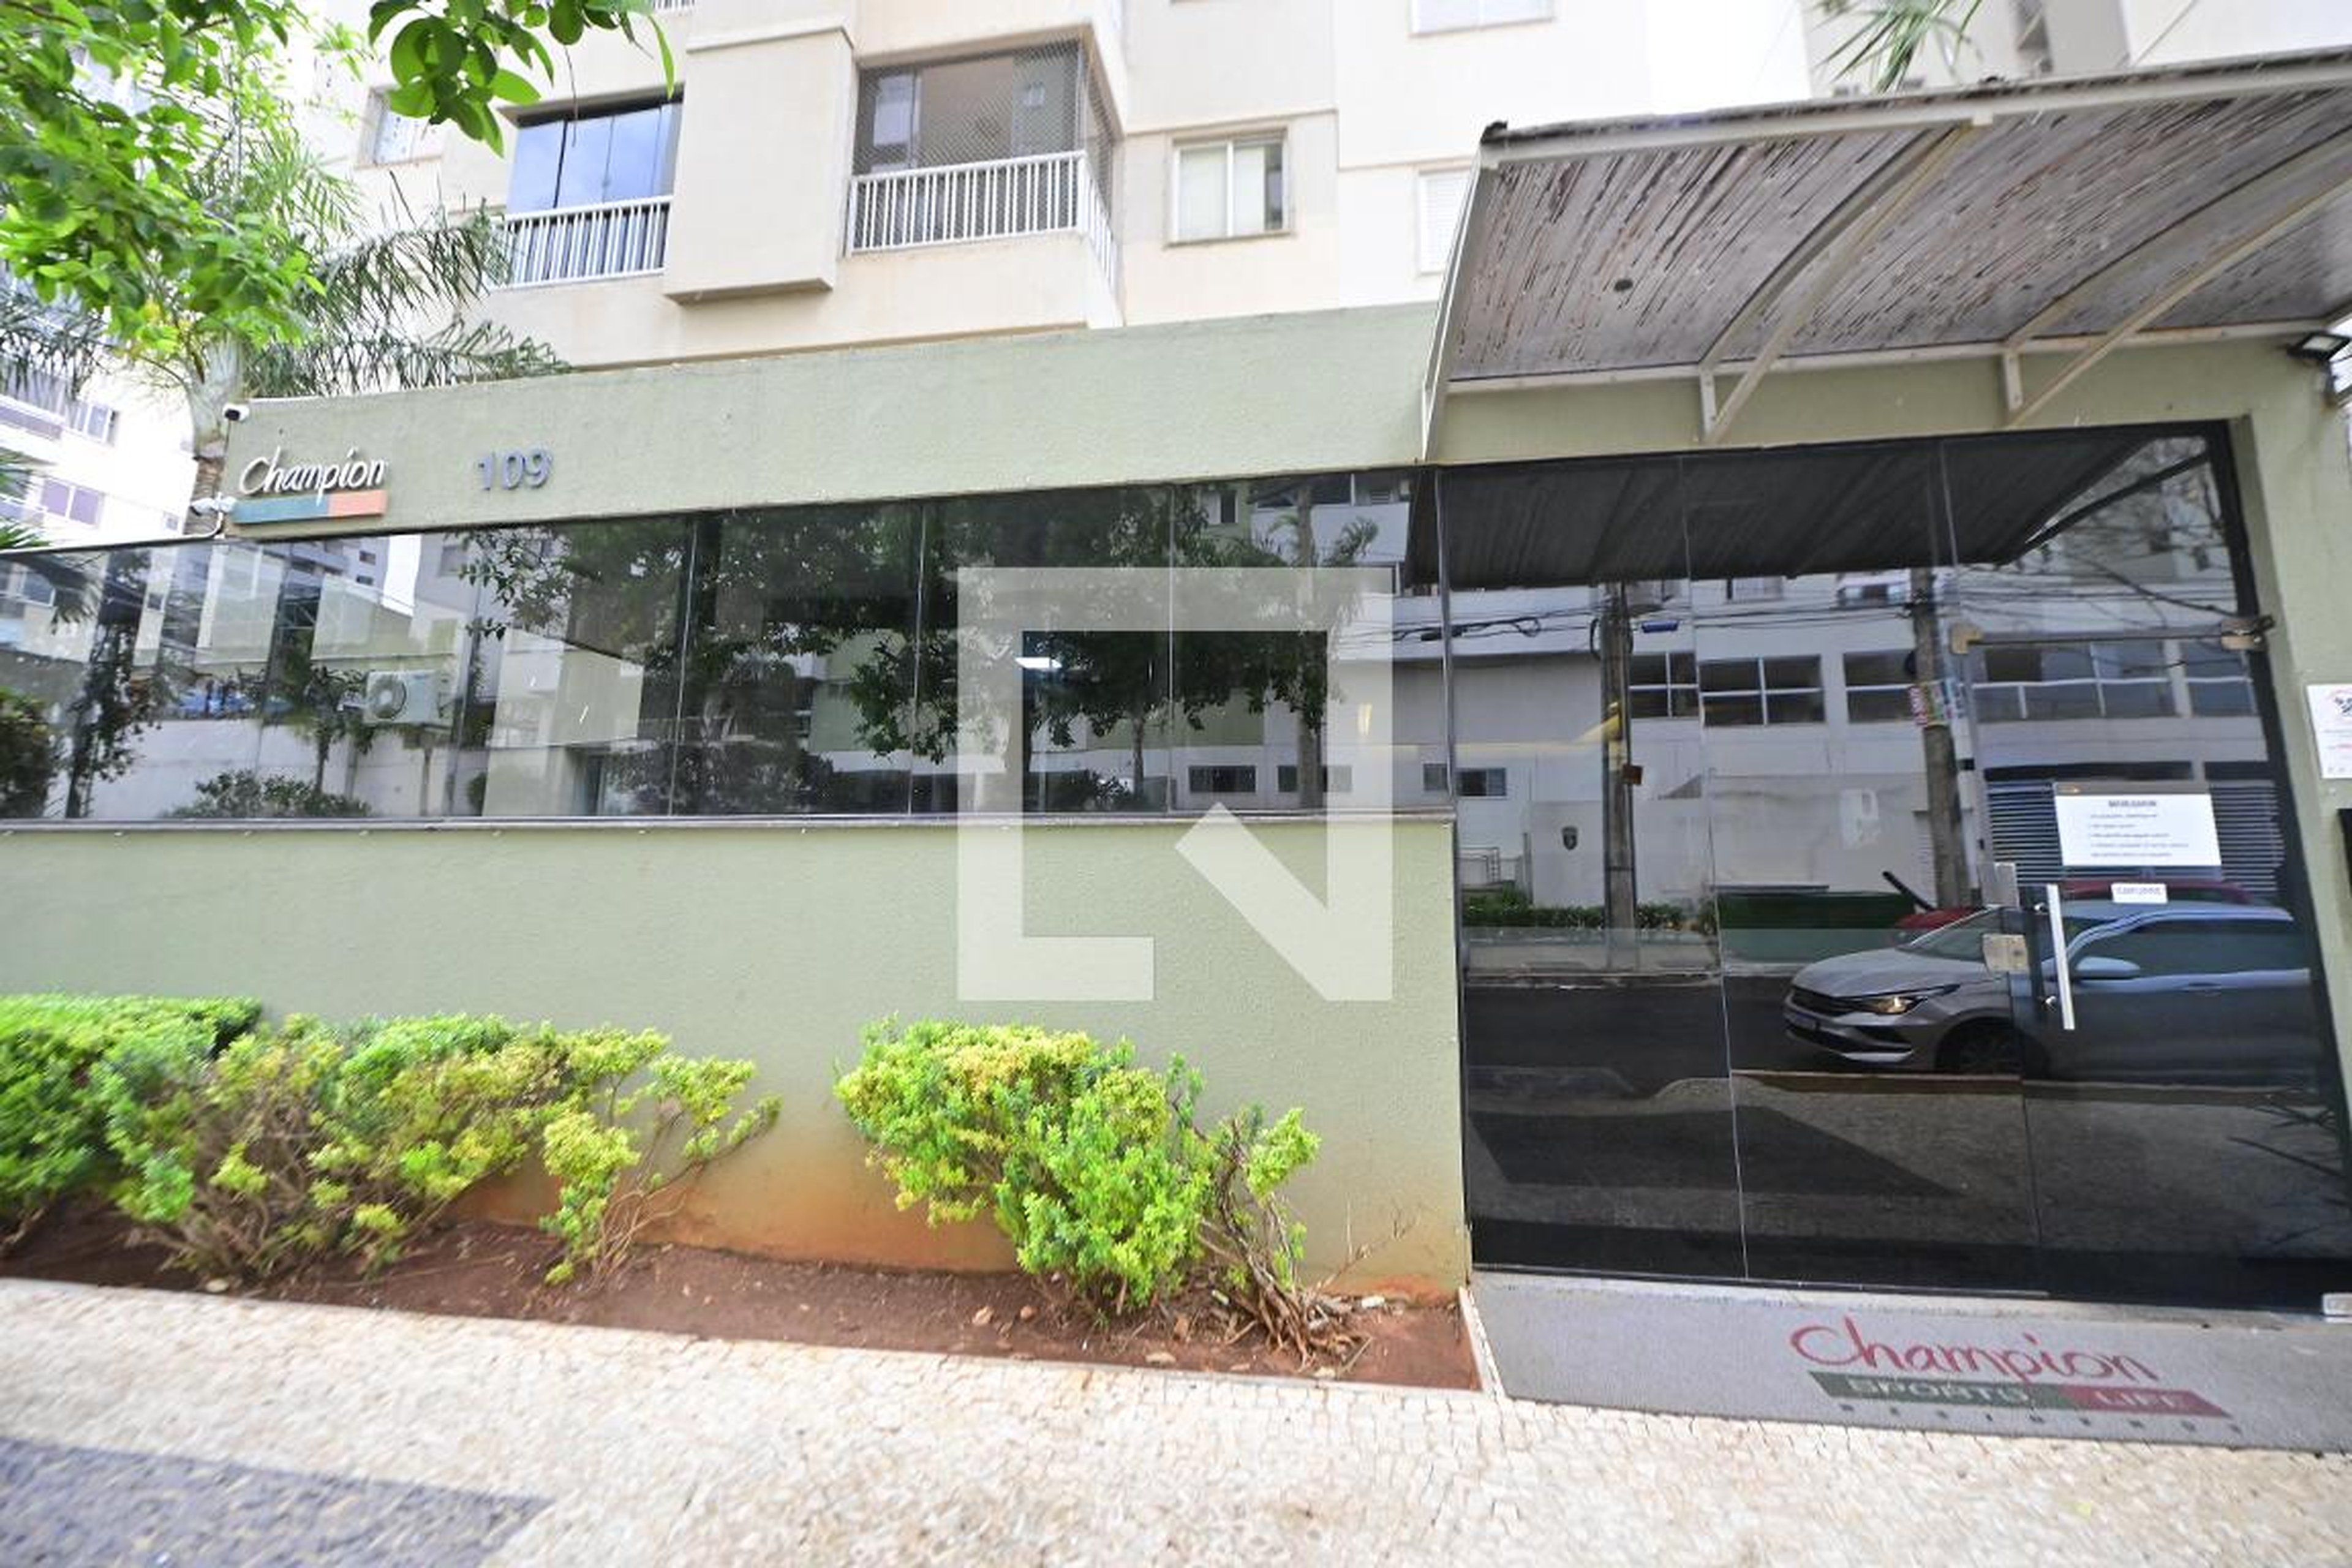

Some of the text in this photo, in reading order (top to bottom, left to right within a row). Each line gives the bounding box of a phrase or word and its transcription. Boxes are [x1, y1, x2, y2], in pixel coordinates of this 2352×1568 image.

[238, 445, 387, 507] Champion
[477, 445, 551, 490] 109
[1790, 1315, 2160, 1387] Champion
